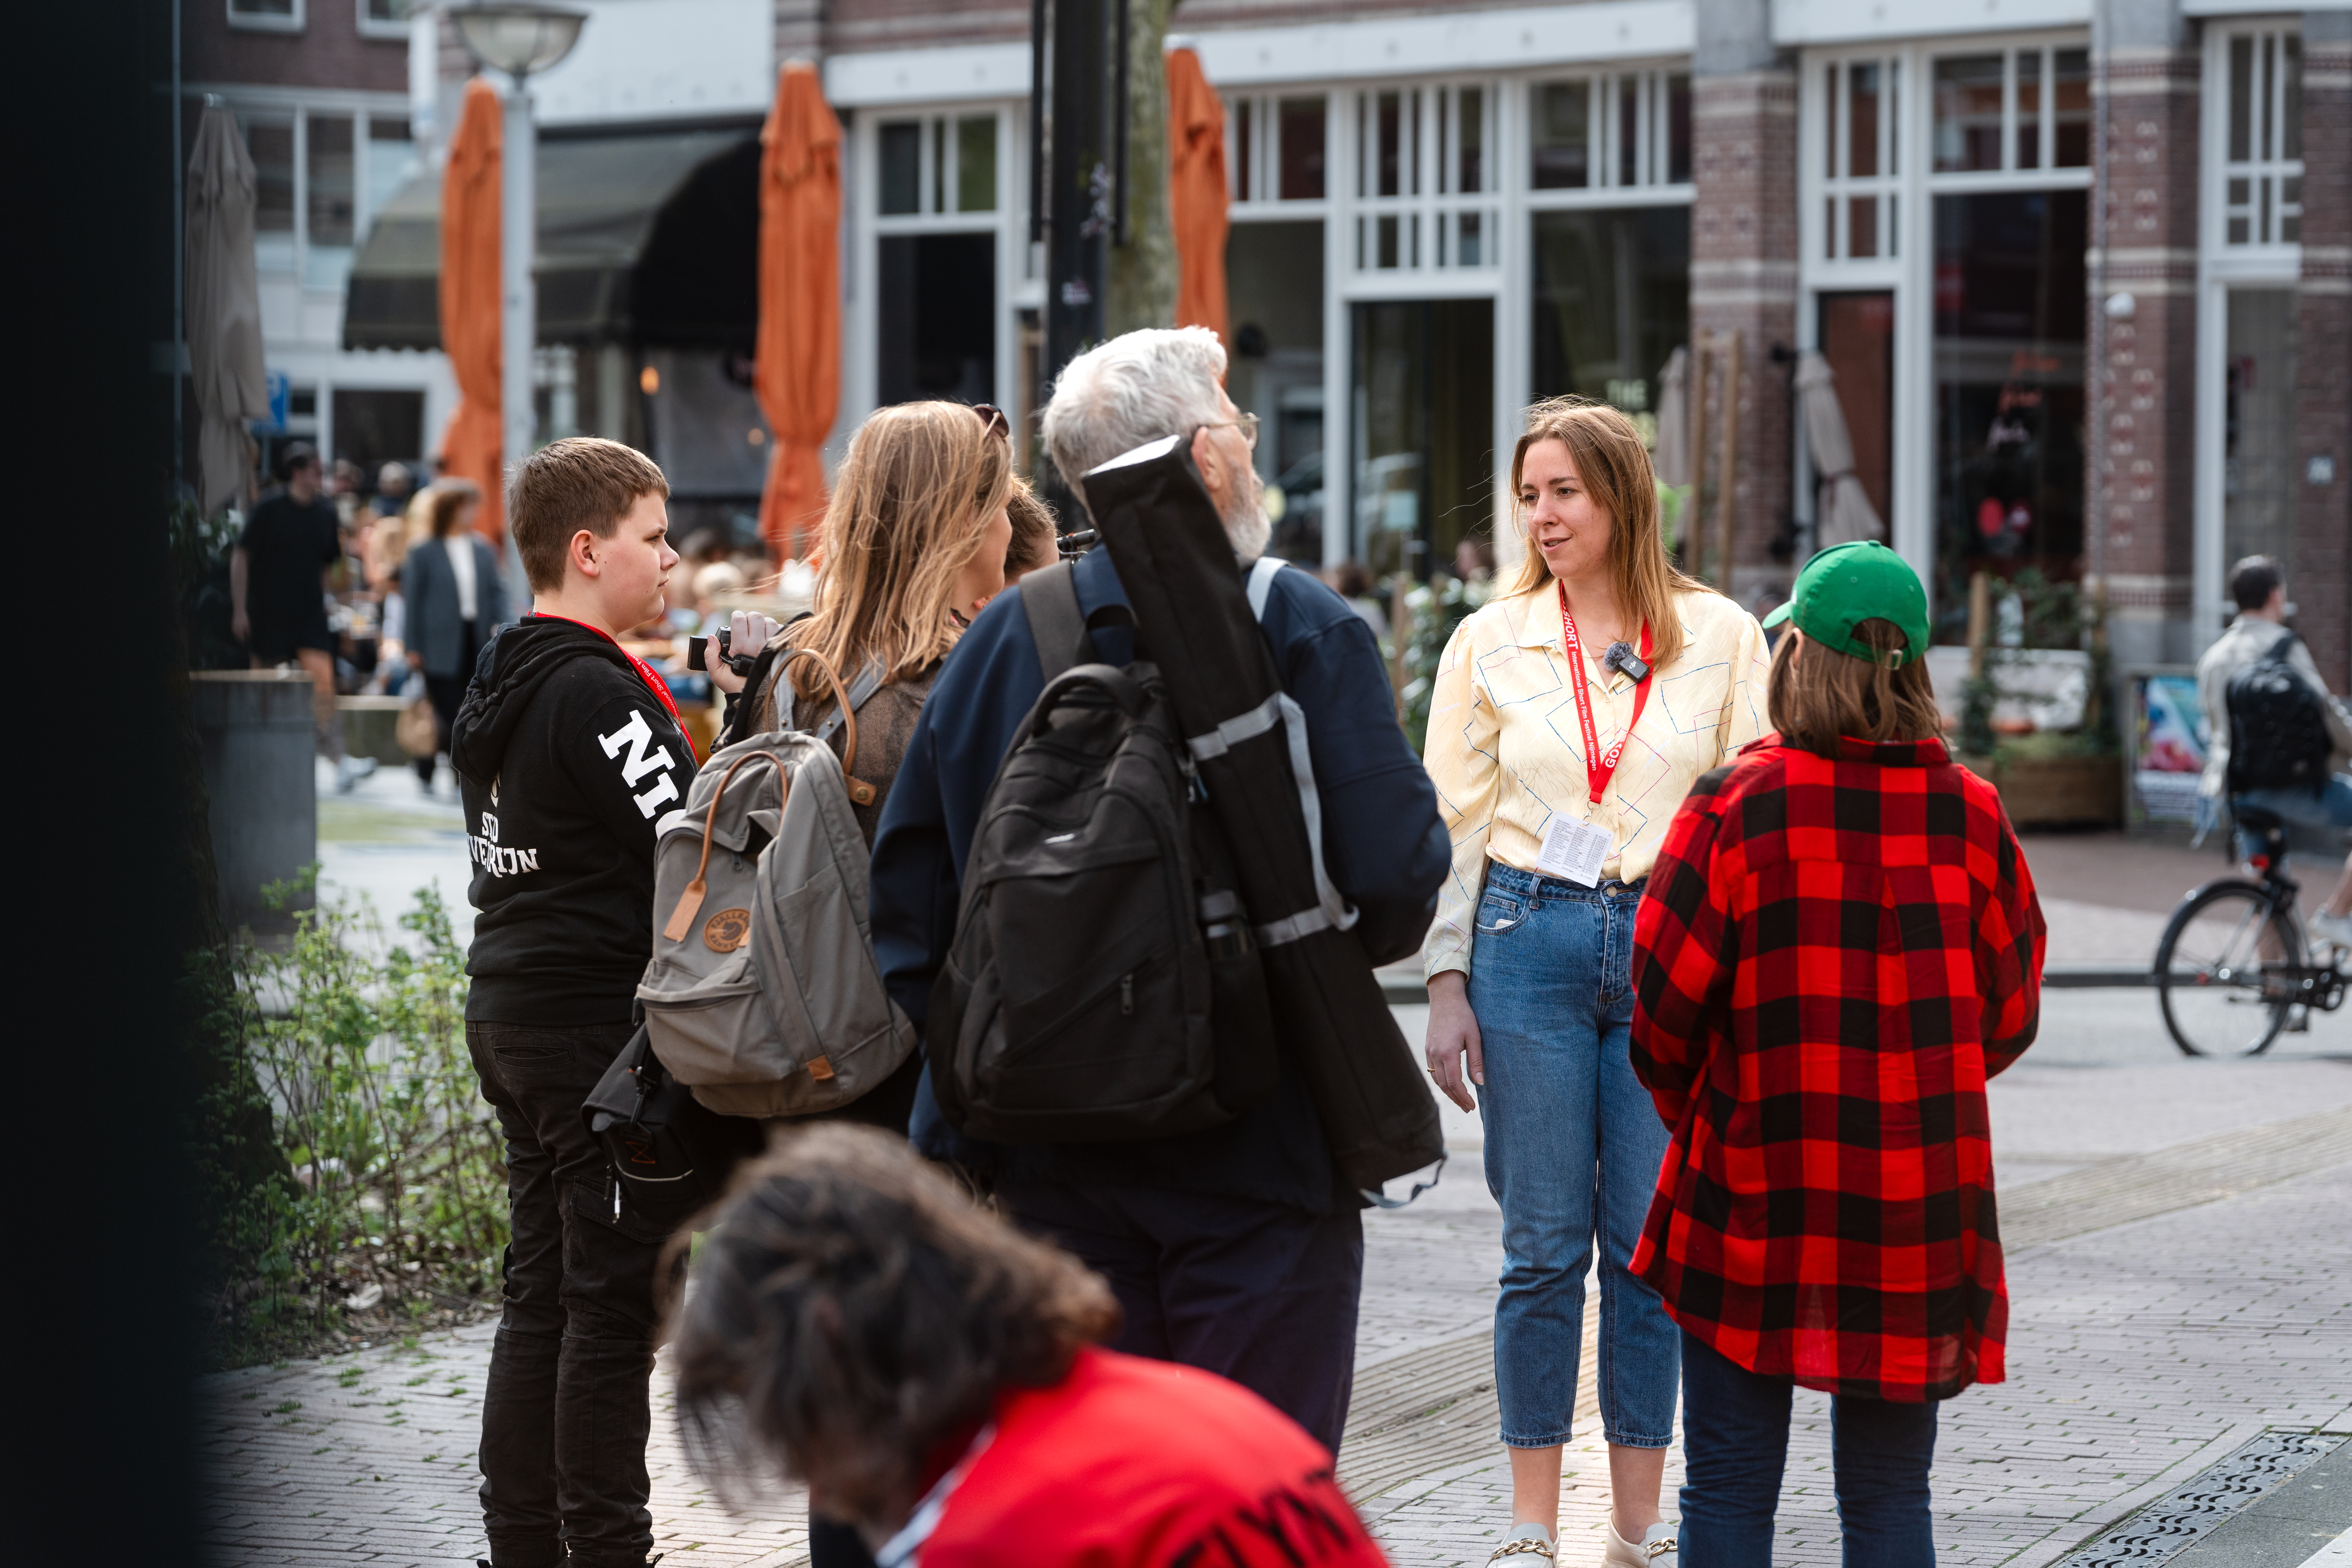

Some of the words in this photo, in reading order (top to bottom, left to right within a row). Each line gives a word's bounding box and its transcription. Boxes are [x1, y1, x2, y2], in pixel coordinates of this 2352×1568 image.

[641, 664, 652, 677] Film
[651, 675, 664, 691] Short
[1571, 652, 1582, 688] International
[1584, 720, 1593, 741] Festival
